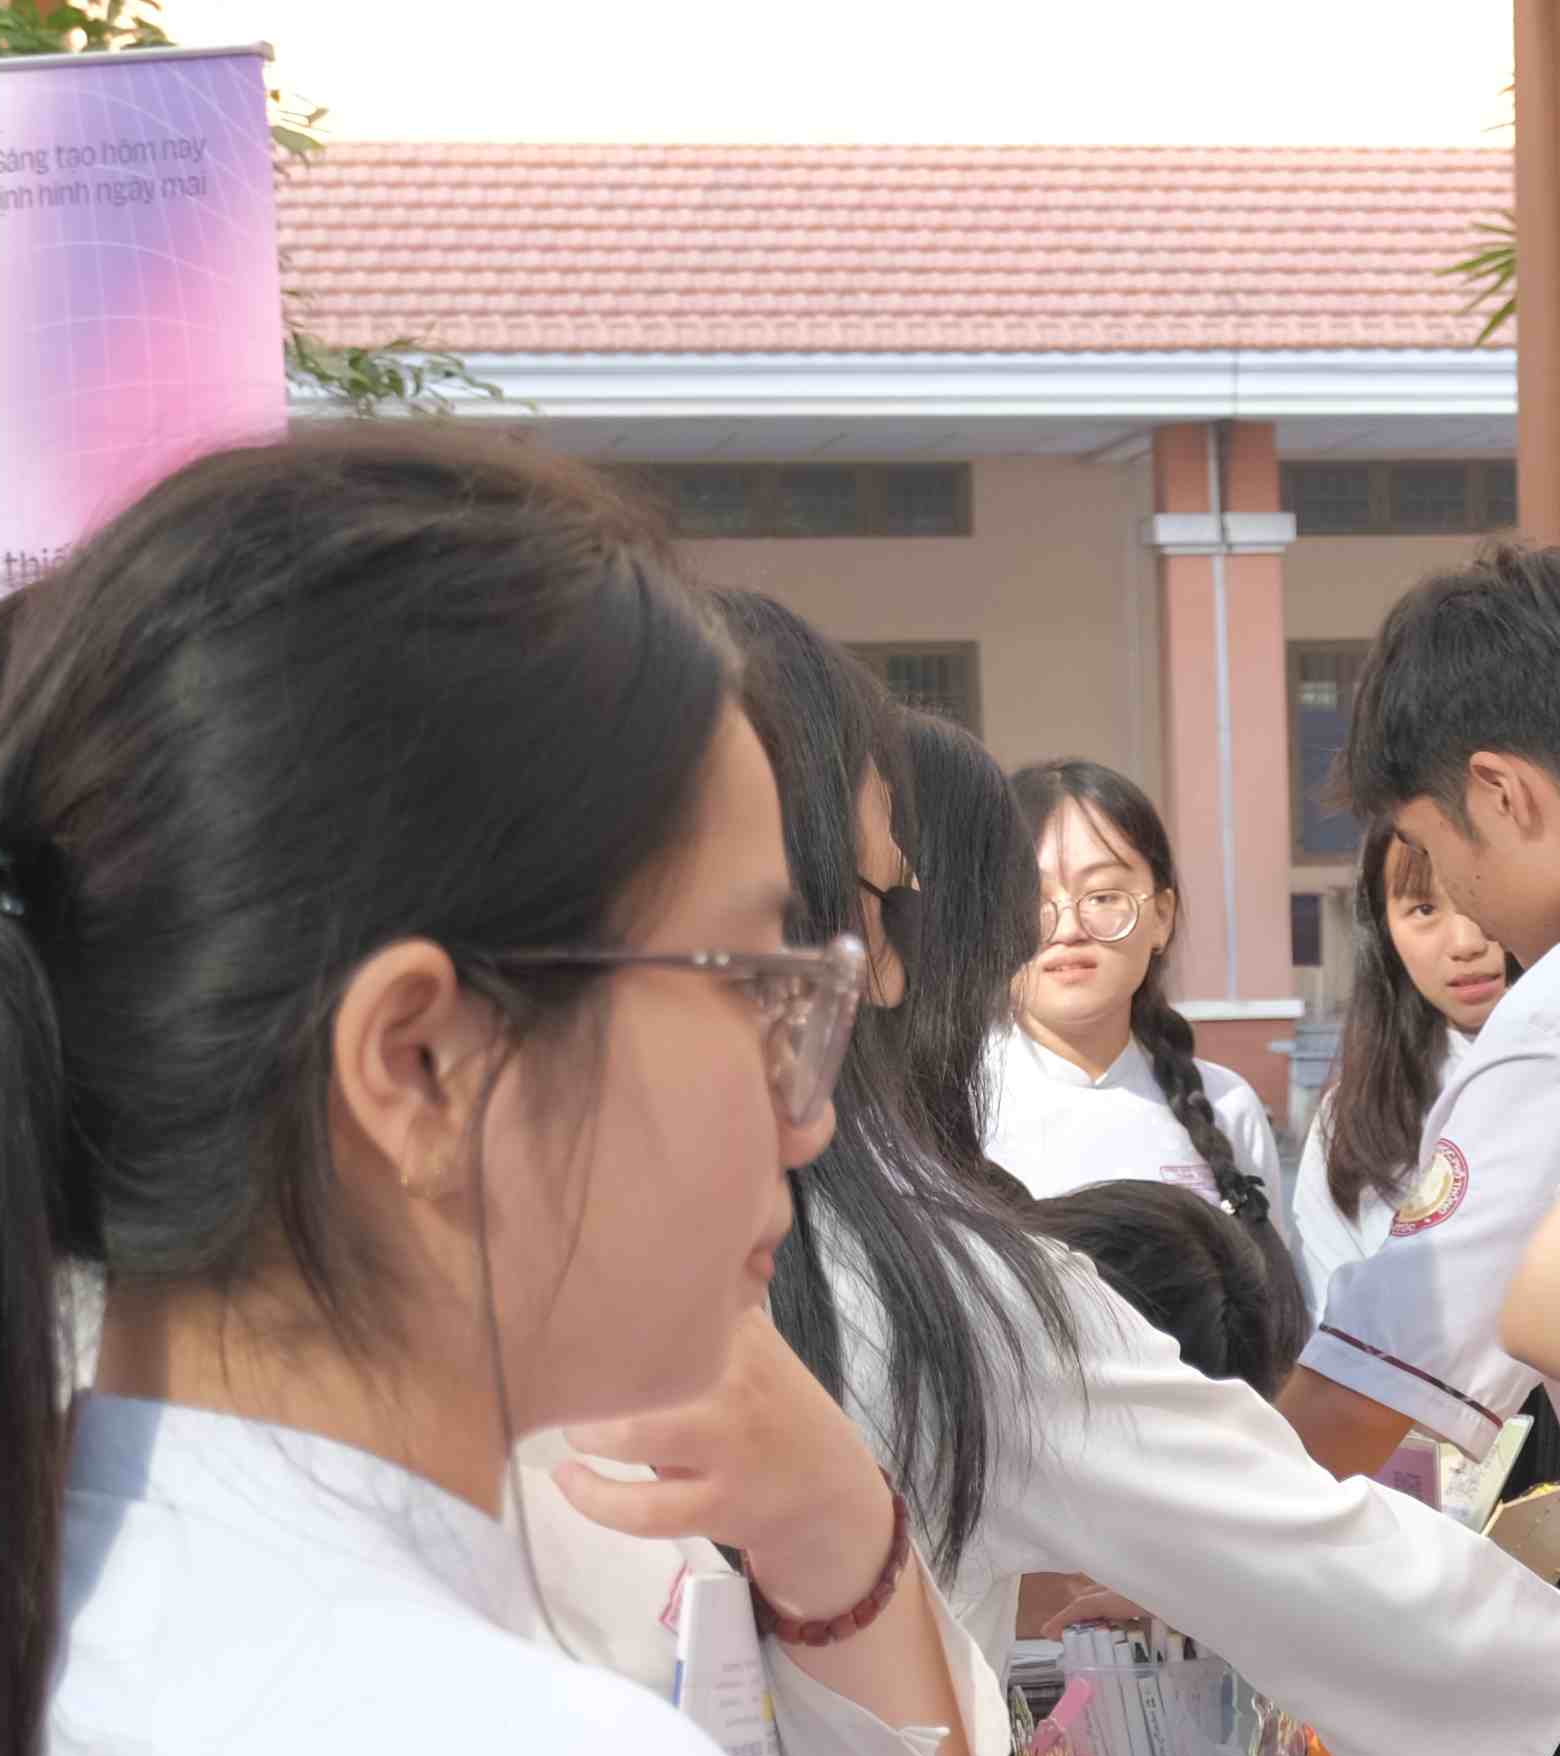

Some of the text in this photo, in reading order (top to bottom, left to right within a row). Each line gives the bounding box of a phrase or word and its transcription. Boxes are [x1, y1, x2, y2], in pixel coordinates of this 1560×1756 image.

[56, 144, 95, 169] tạo
[100, 139, 157, 163] hôm
[161, 136, 208, 163] nay
[95, 175, 156, 206] ngày
[161, 174, 208, 199] mai
